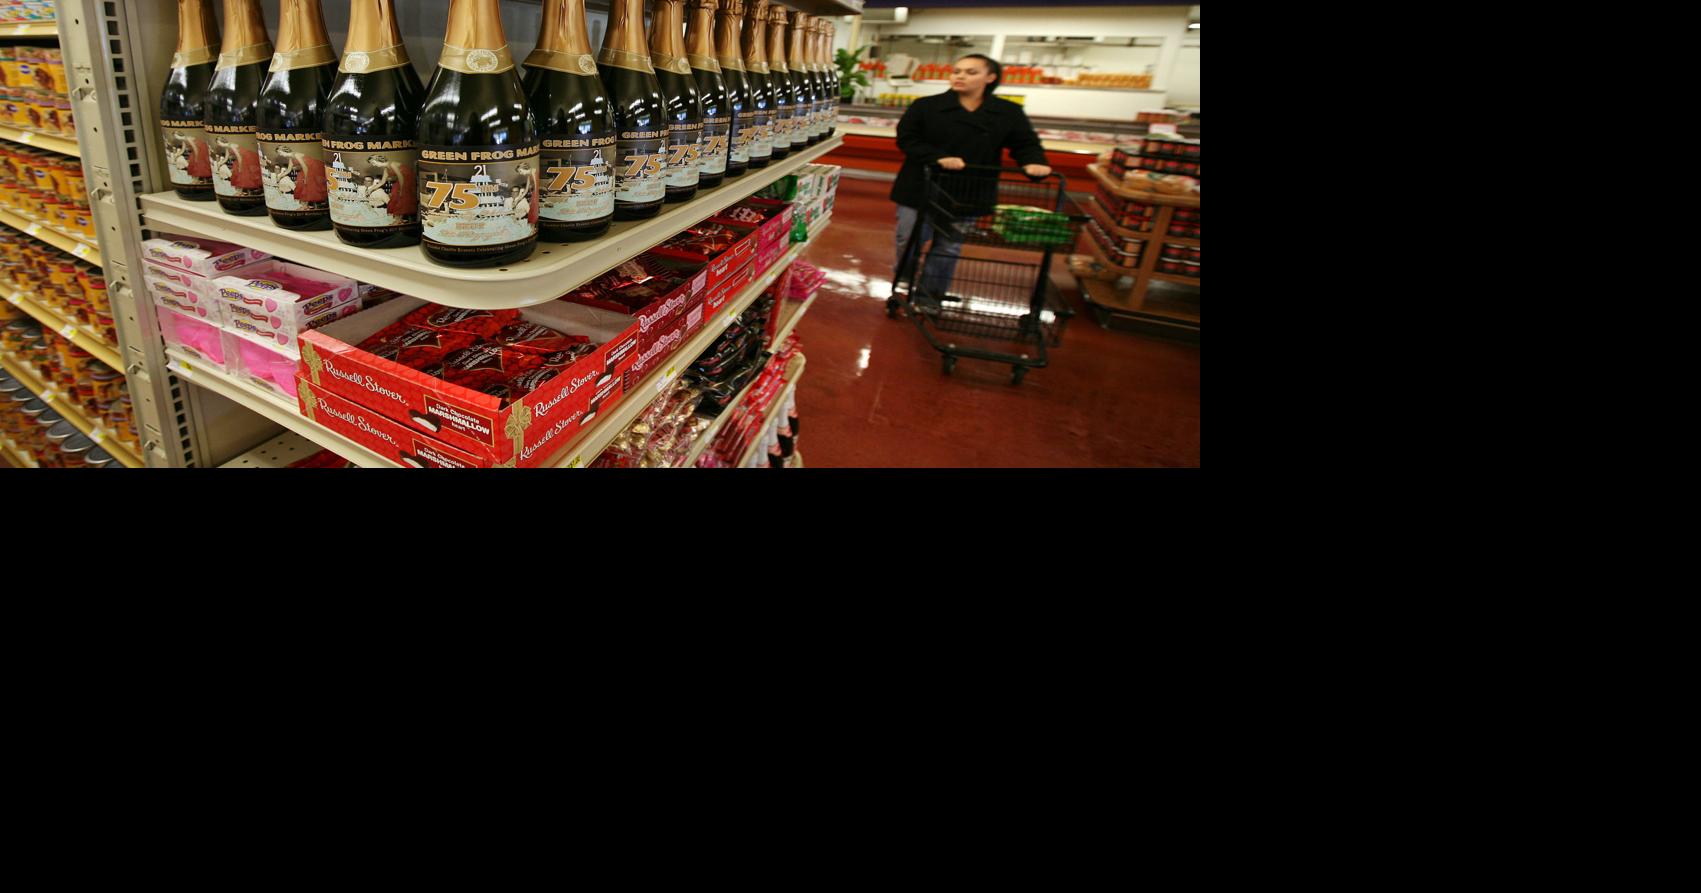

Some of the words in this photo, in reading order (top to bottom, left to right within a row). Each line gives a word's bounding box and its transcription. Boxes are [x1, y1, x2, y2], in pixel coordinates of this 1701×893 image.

[330, 140, 364, 150] FROG
[542, 139, 590, 148] GREEN
[621, 131, 659, 139] GREEN
[703, 136, 727, 153] 75
[421, 150, 468, 161] GREEN
[470, 149, 514, 161] FROG
[624, 153, 662, 176] 75
[669, 143, 701, 165] 75
[474, 164, 487, 177] 21
[546, 165, 597, 191] 75
[425, 181, 481, 211] 75
[323, 359, 365, 387] Russell
[364, 375, 406, 405] Stover
[533, 386, 570, 418] Russell
[569, 370, 598, 394] Stover
[317, 397, 358, 426] Russell
[357, 415, 397, 445] Stover
[428, 406, 490, 435] MARSHMALLOW
[435, 403, 449, 414] Dark
[449, 408, 480, 425] Chocolate
